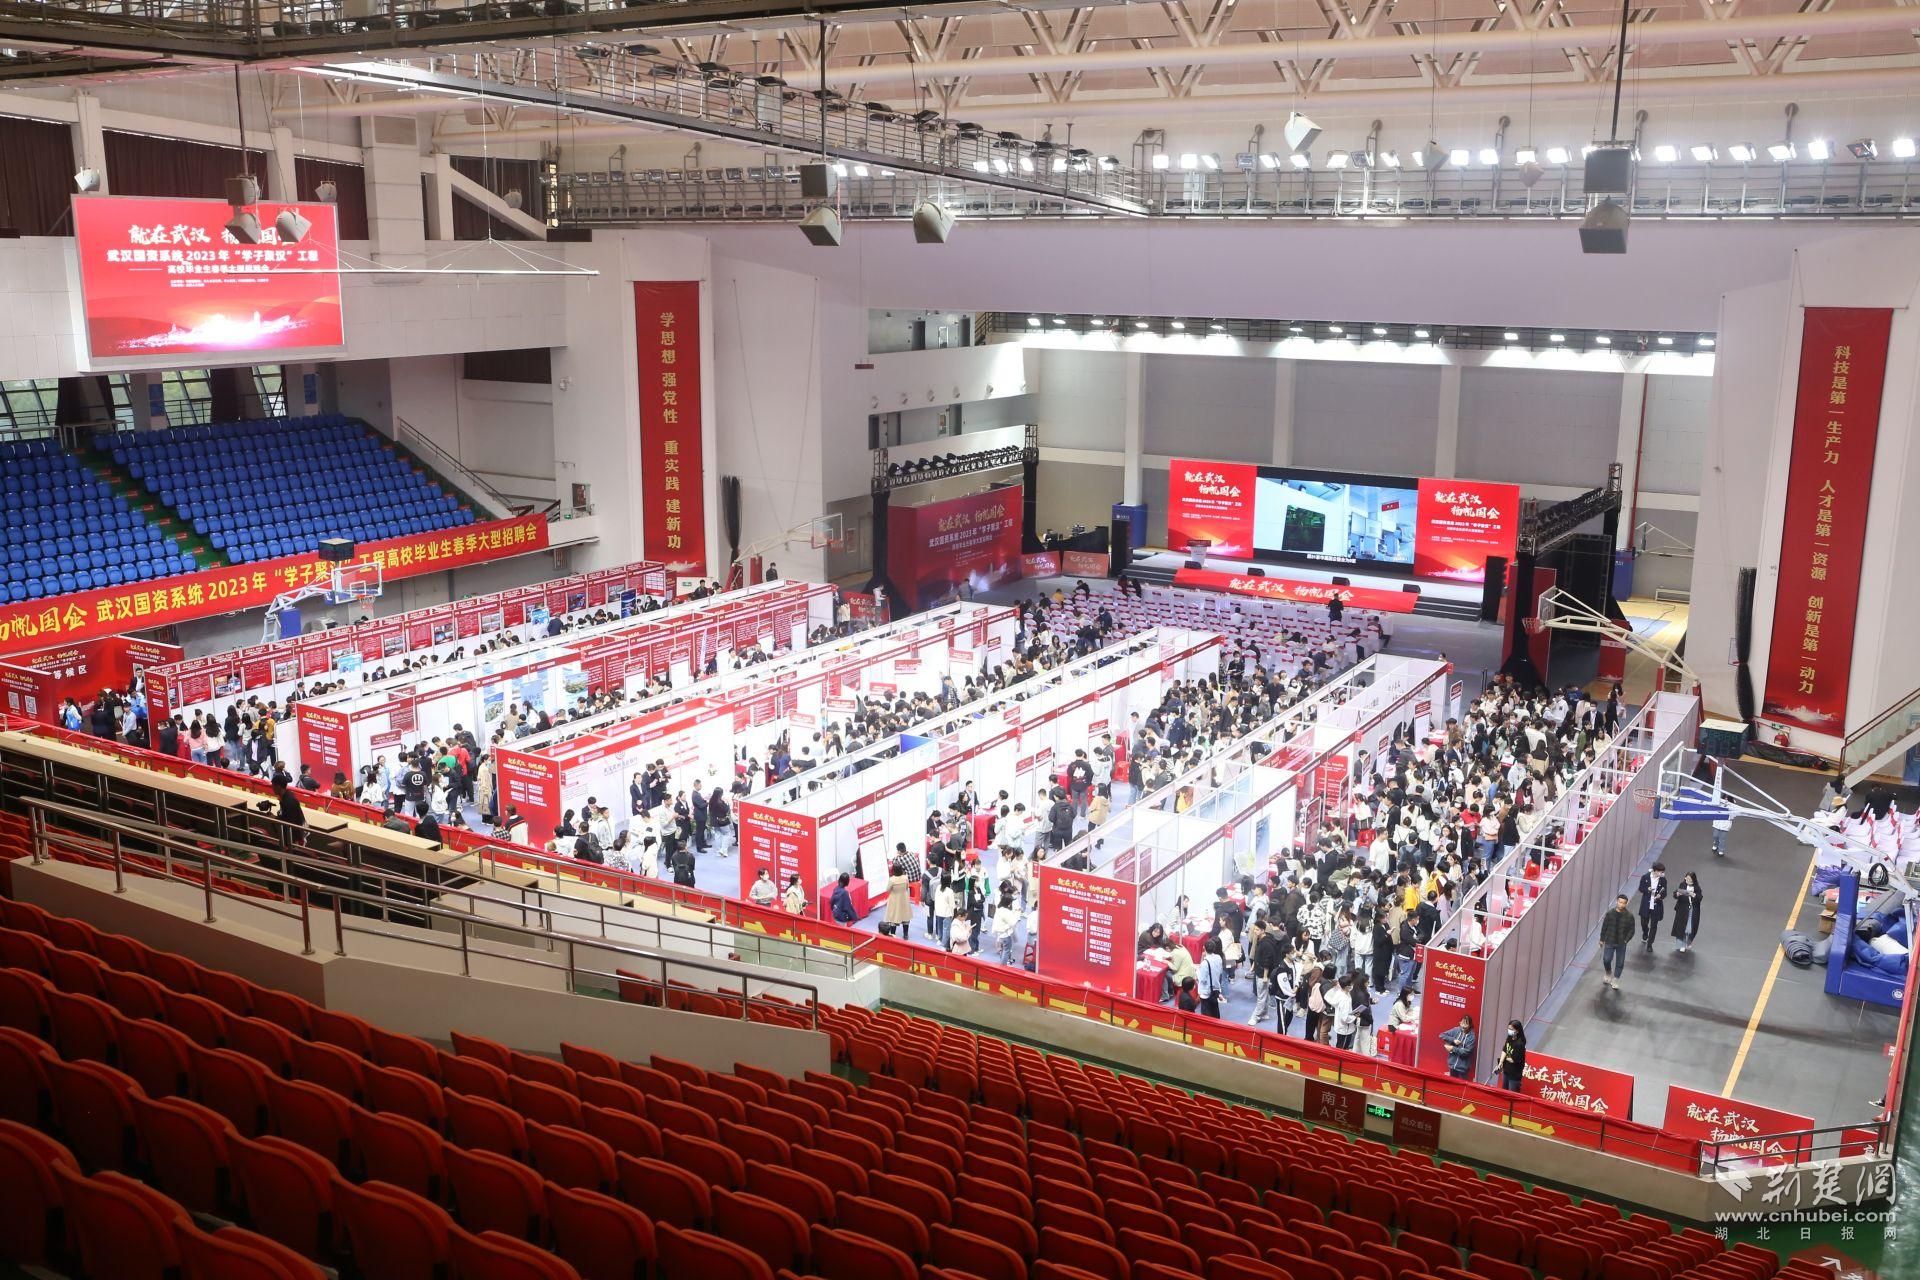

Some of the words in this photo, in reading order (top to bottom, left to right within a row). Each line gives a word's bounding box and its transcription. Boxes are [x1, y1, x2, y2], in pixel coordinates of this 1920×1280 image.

[128, 223, 211, 246] 就在武汉
[660, 312, 676, 364] 学思想
[662, 372, 678, 424] 强党性
[1823, 345, 1851, 465] 科技是第一生产力
[664, 440, 680, 491] 重实践
[665, 499, 681, 549] 建新功
[1810, 479, 1836, 582] 人才是第一资源
[1798, 595, 1824, 694] 创新是第一动力
[1522, 1062, 1586, 1090] 就在武汉
[1539, 1085, 1609, 1114] 扬帆国企
[1686, 1102, 1760, 1133] 就在武汉
